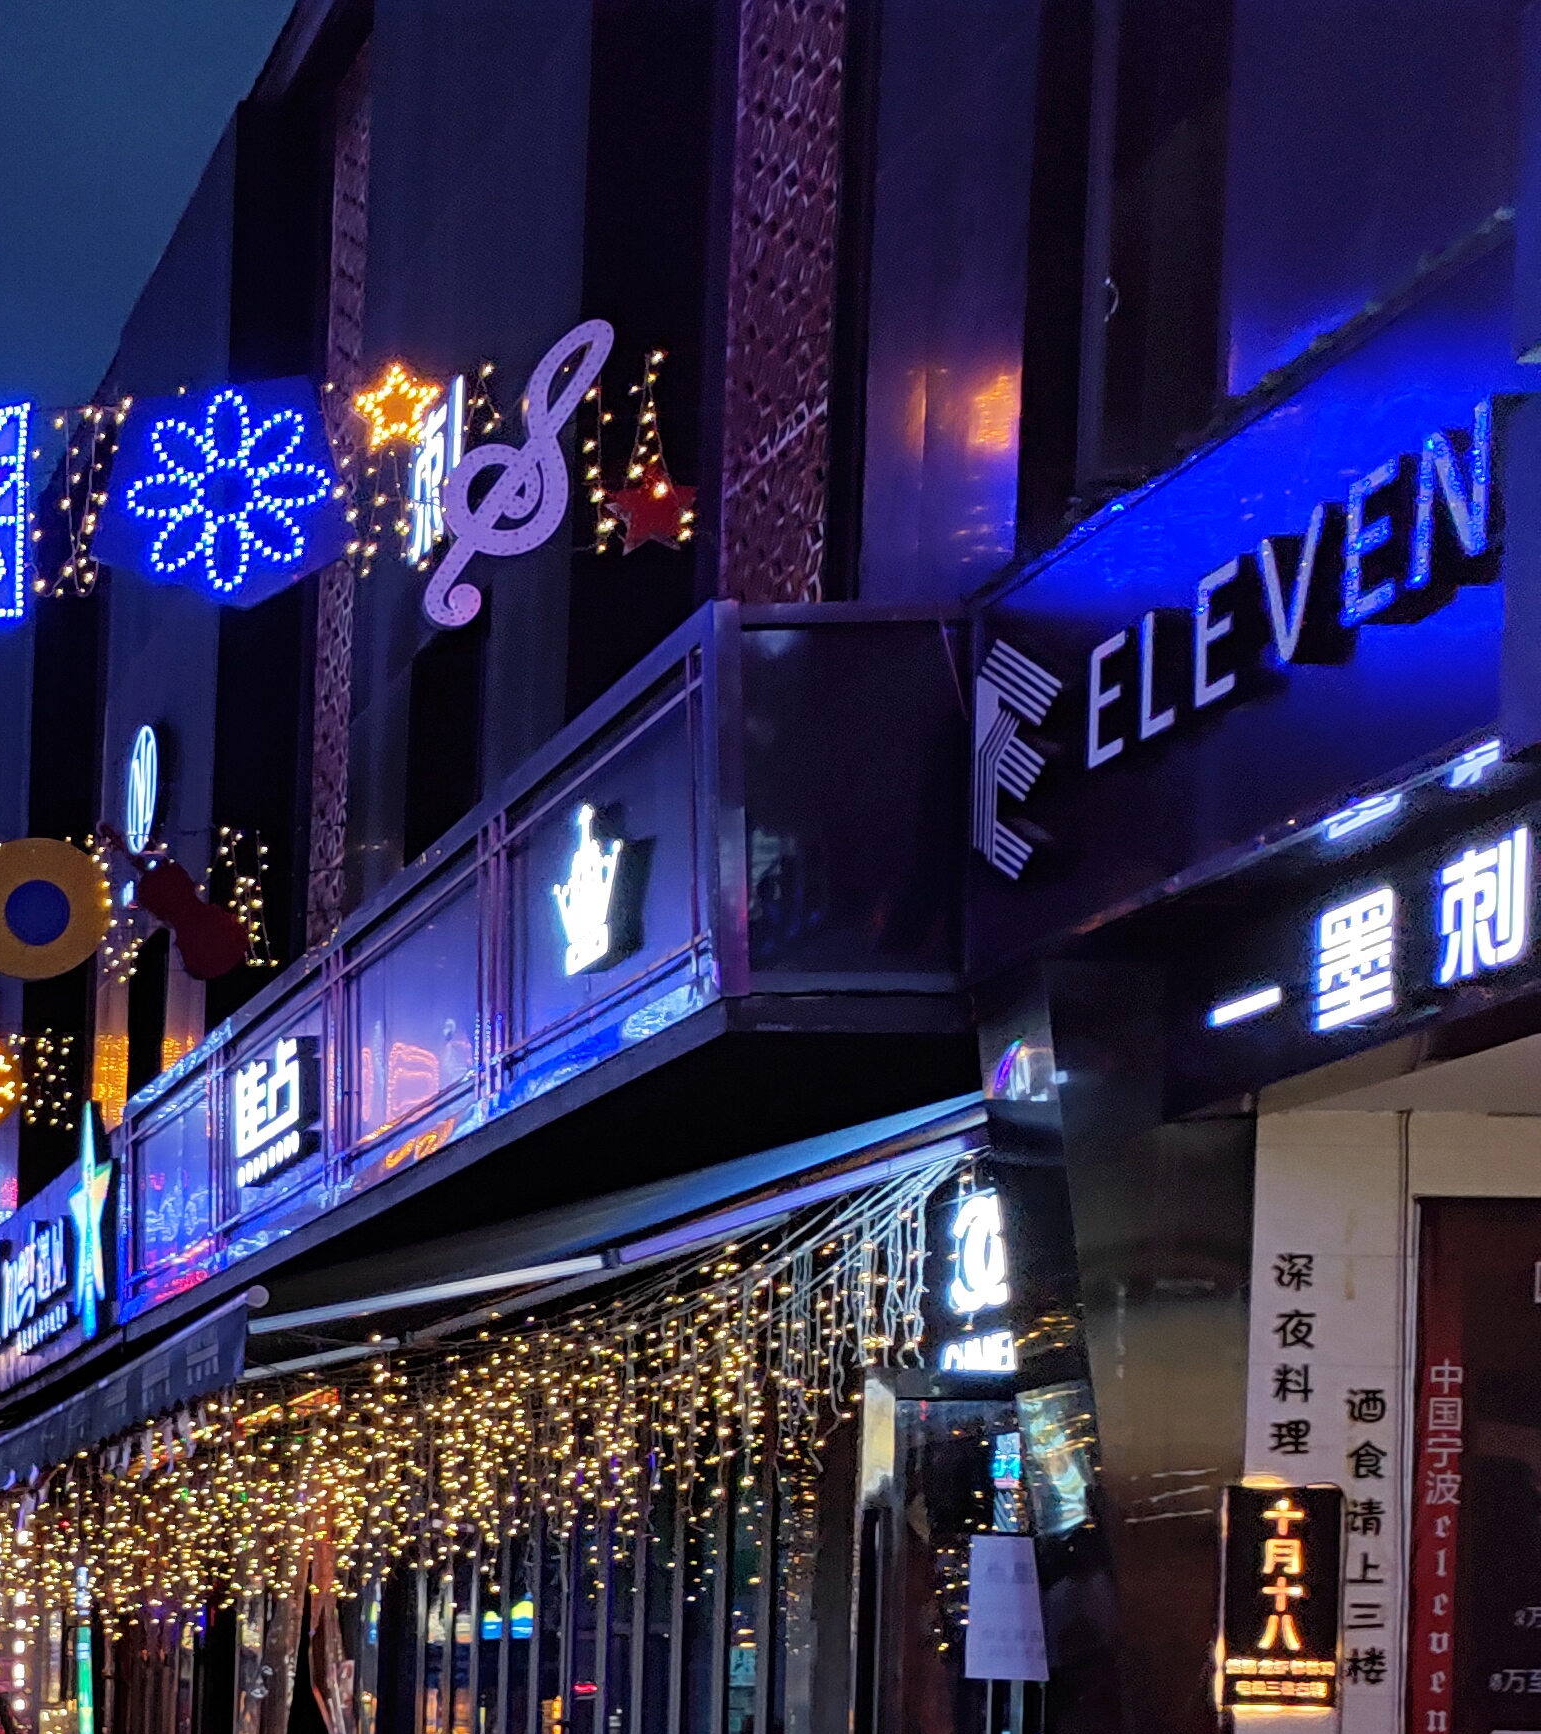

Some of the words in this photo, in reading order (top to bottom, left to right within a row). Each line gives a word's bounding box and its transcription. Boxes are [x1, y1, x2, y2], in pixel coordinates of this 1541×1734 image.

[1087, 397, 1492, 771] ELEVEN
[1269, 1252, 1317, 1456] 深夜料理
[1424, 1357, 1464, 1506] 中国宁波
[1257, 1497, 1306, 1651] 十月十八
[1345, 1388, 1389, 1686] 酒食请上三楼
